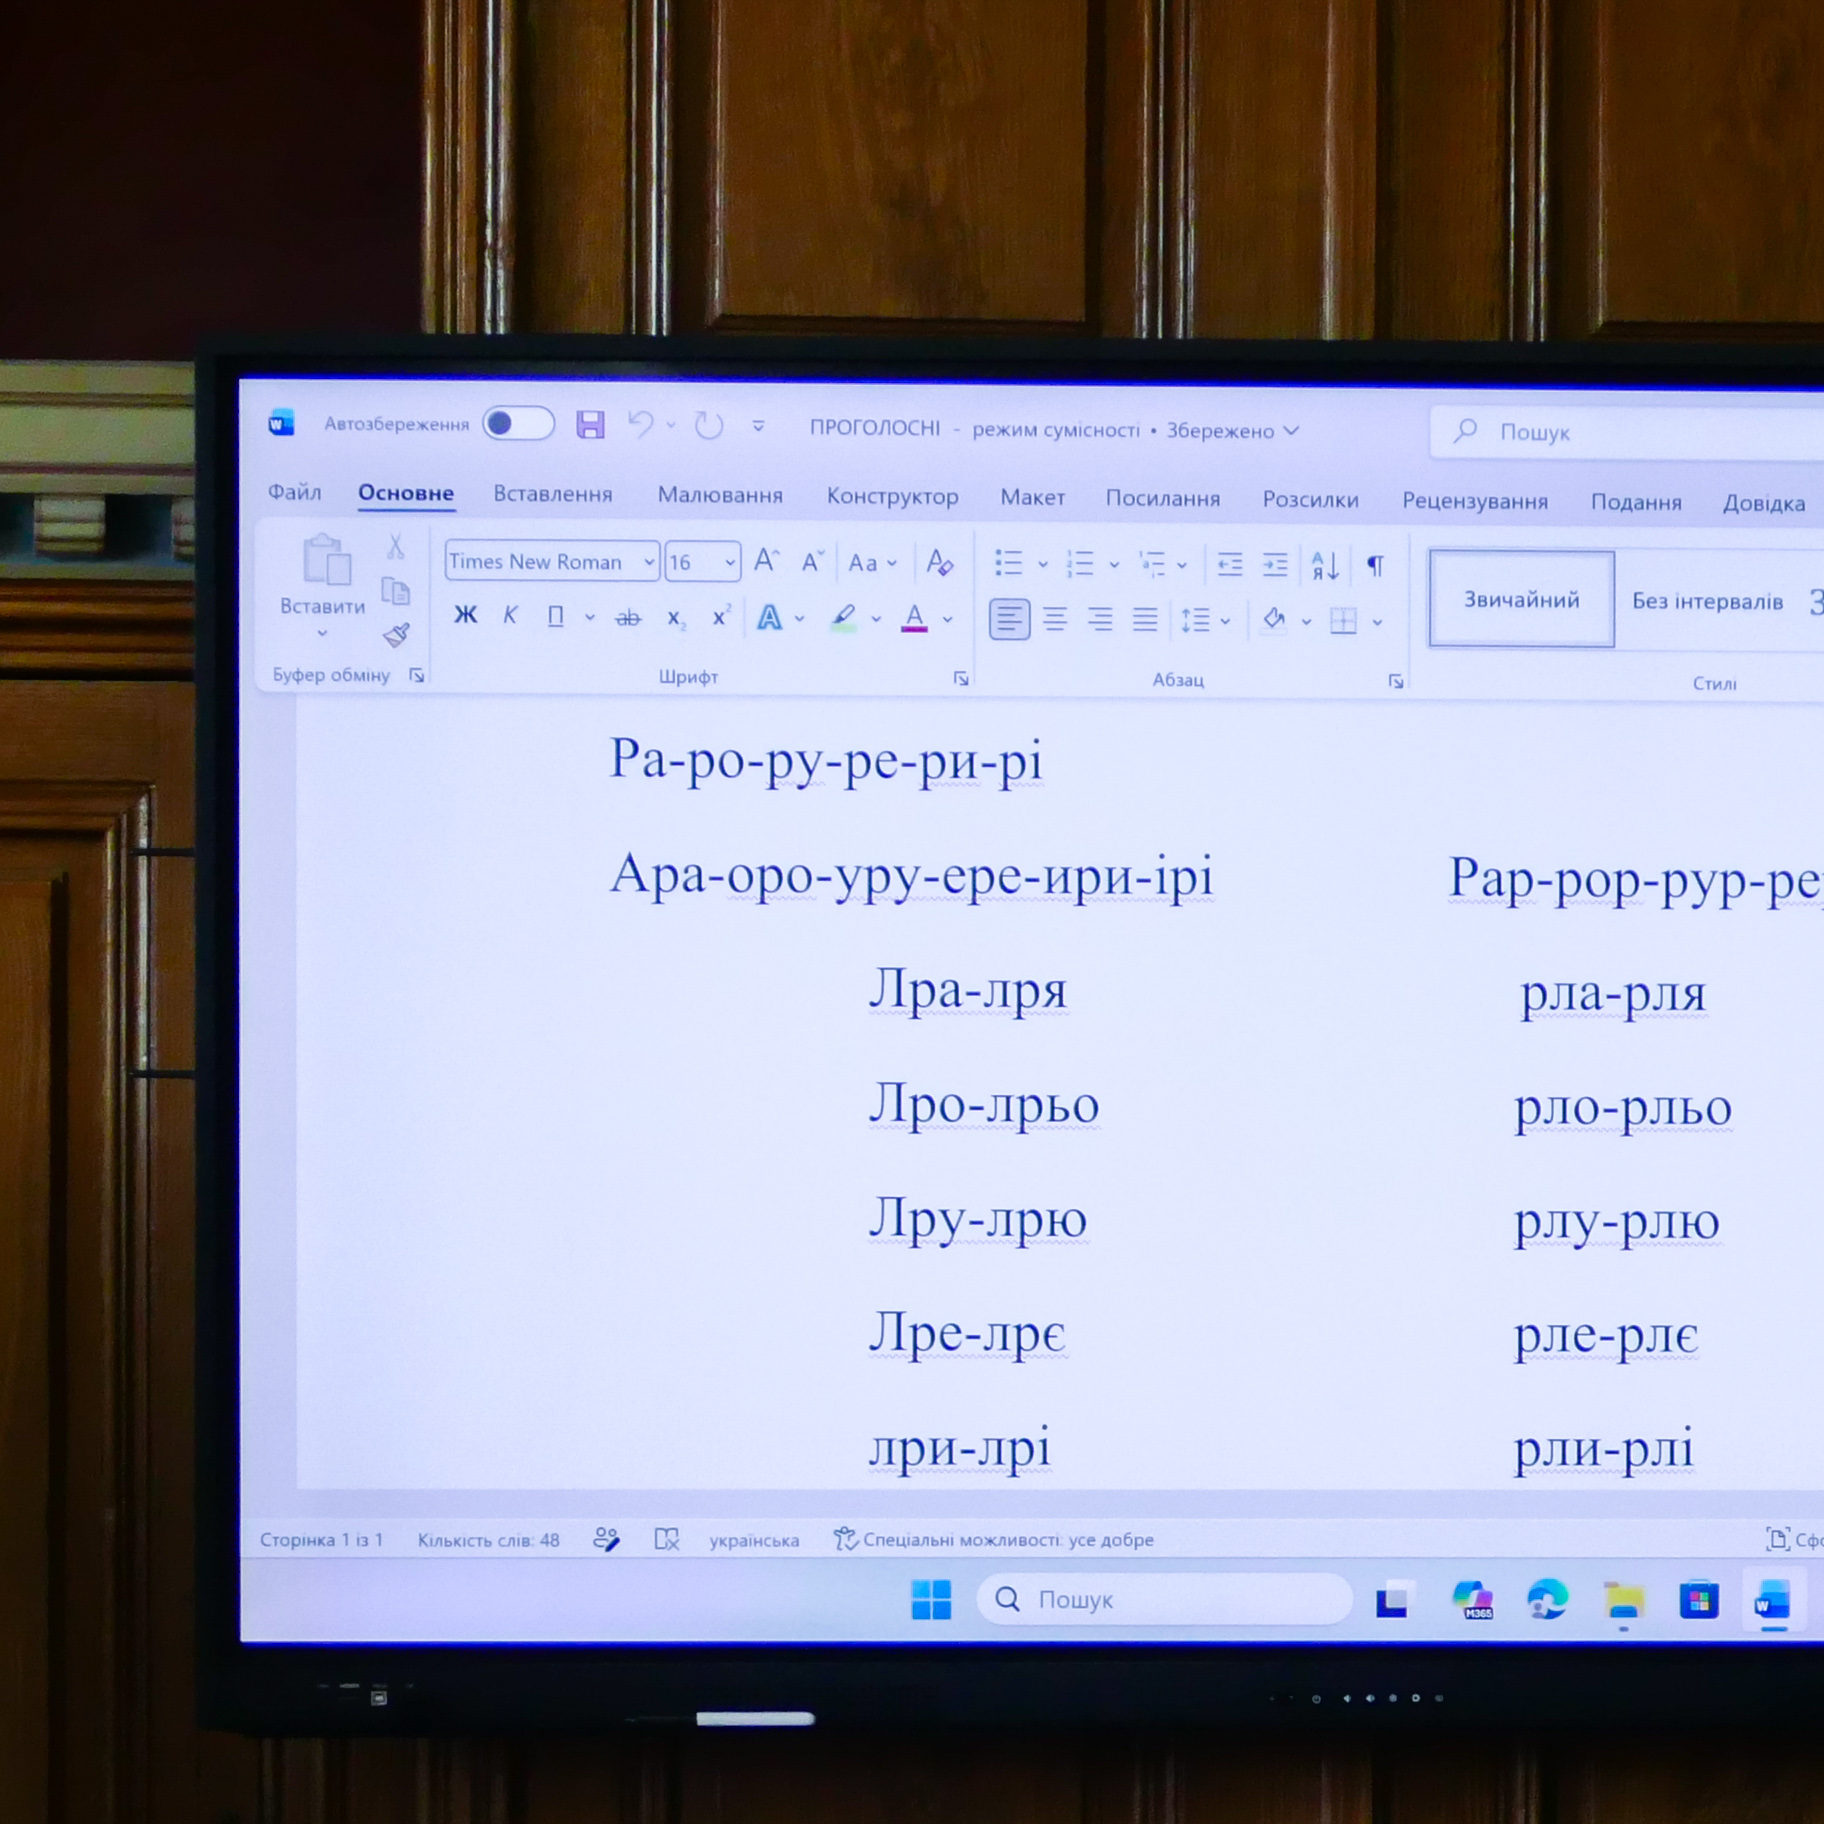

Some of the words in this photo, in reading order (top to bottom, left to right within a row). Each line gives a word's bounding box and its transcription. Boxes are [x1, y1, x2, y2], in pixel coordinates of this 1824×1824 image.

[323, 415, 471, 435] Автозбереження
[809, 417, 941, 437] ПРОГОЛОСНІ
[972, 422, 1039, 440] режим
[1043, 421, 1141, 441] сумісності
[1167, 420, 1275, 444] Збережено
[1501, 422, 1571, 447] Пошук
[267, 482, 323, 501] Файл
[357, 483, 455, 502] Основне
[494, 483, 613, 503] Вставлення
[657, 484, 783, 504] Малювання
[827, 486, 960, 511] Конструктор
[1001, 487, 1066, 506] Макет
[1105, 487, 1221, 507] Посилання
[1263, 489, 1359, 509] Розсилки
[1402, 490, 1549, 515] Рецензування
[1591, 492, 1682, 514] Подання
[1721, 493, 1806, 516] Довідка
[448, 552, 504, 570] Times
[509, 552, 552, 571] New
[556, 552, 622, 571] Roman
[670, 553, 691, 571] 16
[280, 596, 366, 615] Вставити
[1464, 589, 1581, 609] Звичайний
[1633, 591, 1669, 610] Без
[1675, 592, 1784, 612] інтервалів
[273, 666, 324, 686] Буфер
[330, 666, 392, 687] обміну
[658, 668, 719, 688] Шрифт
[1152, 671, 1206, 690] Абзац
[1692, 675, 1738, 691] Стилі
[612, 736, 1041, 792] Ра-ро-ру-ре-ри-рі
[610, 852, 1212, 908] Ара-оро-уру-ере-ири-ірі
[868, 967, 1066, 1021] Лра-лря
[1521, 982, 1705, 1024] рла-рля
[868, 1081, 1099, 1135] Лро-лрьо
[1515, 1096, 1732, 1137] рло-рльо
[868, 1196, 1087, 1250] Лру-лрю
[1515, 1210, 1720, 1251] рлу-рлю
[868, 1310, 1065, 1364] Лре-лрє
[1515, 1324, 1698, 1365] рле-рлє
[868, 1423, 1050, 1479] лри-лрі
[1514, 1424, 1693, 1479] рли-рлі
[259, 1531, 337, 1552] Сторінка
[342, 1531, 349, 1547] 1
[355, 1533, 370, 1548] із
[375, 1531, 383, 1547] 1
[417, 1532, 493, 1548] Кількість
[497, 1533, 535, 1549] слів:
[538, 1531, 561, 1548] 48
[709, 1533, 800, 1551] українська
[862, 1530, 955, 1549] Спеціальні
[959, 1533, 1064, 1549] можливості:
[1068, 1535, 1097, 1551] усе
[1100, 1531, 1155, 1552] добре
[1039, 1589, 1114, 1614] Пошук
